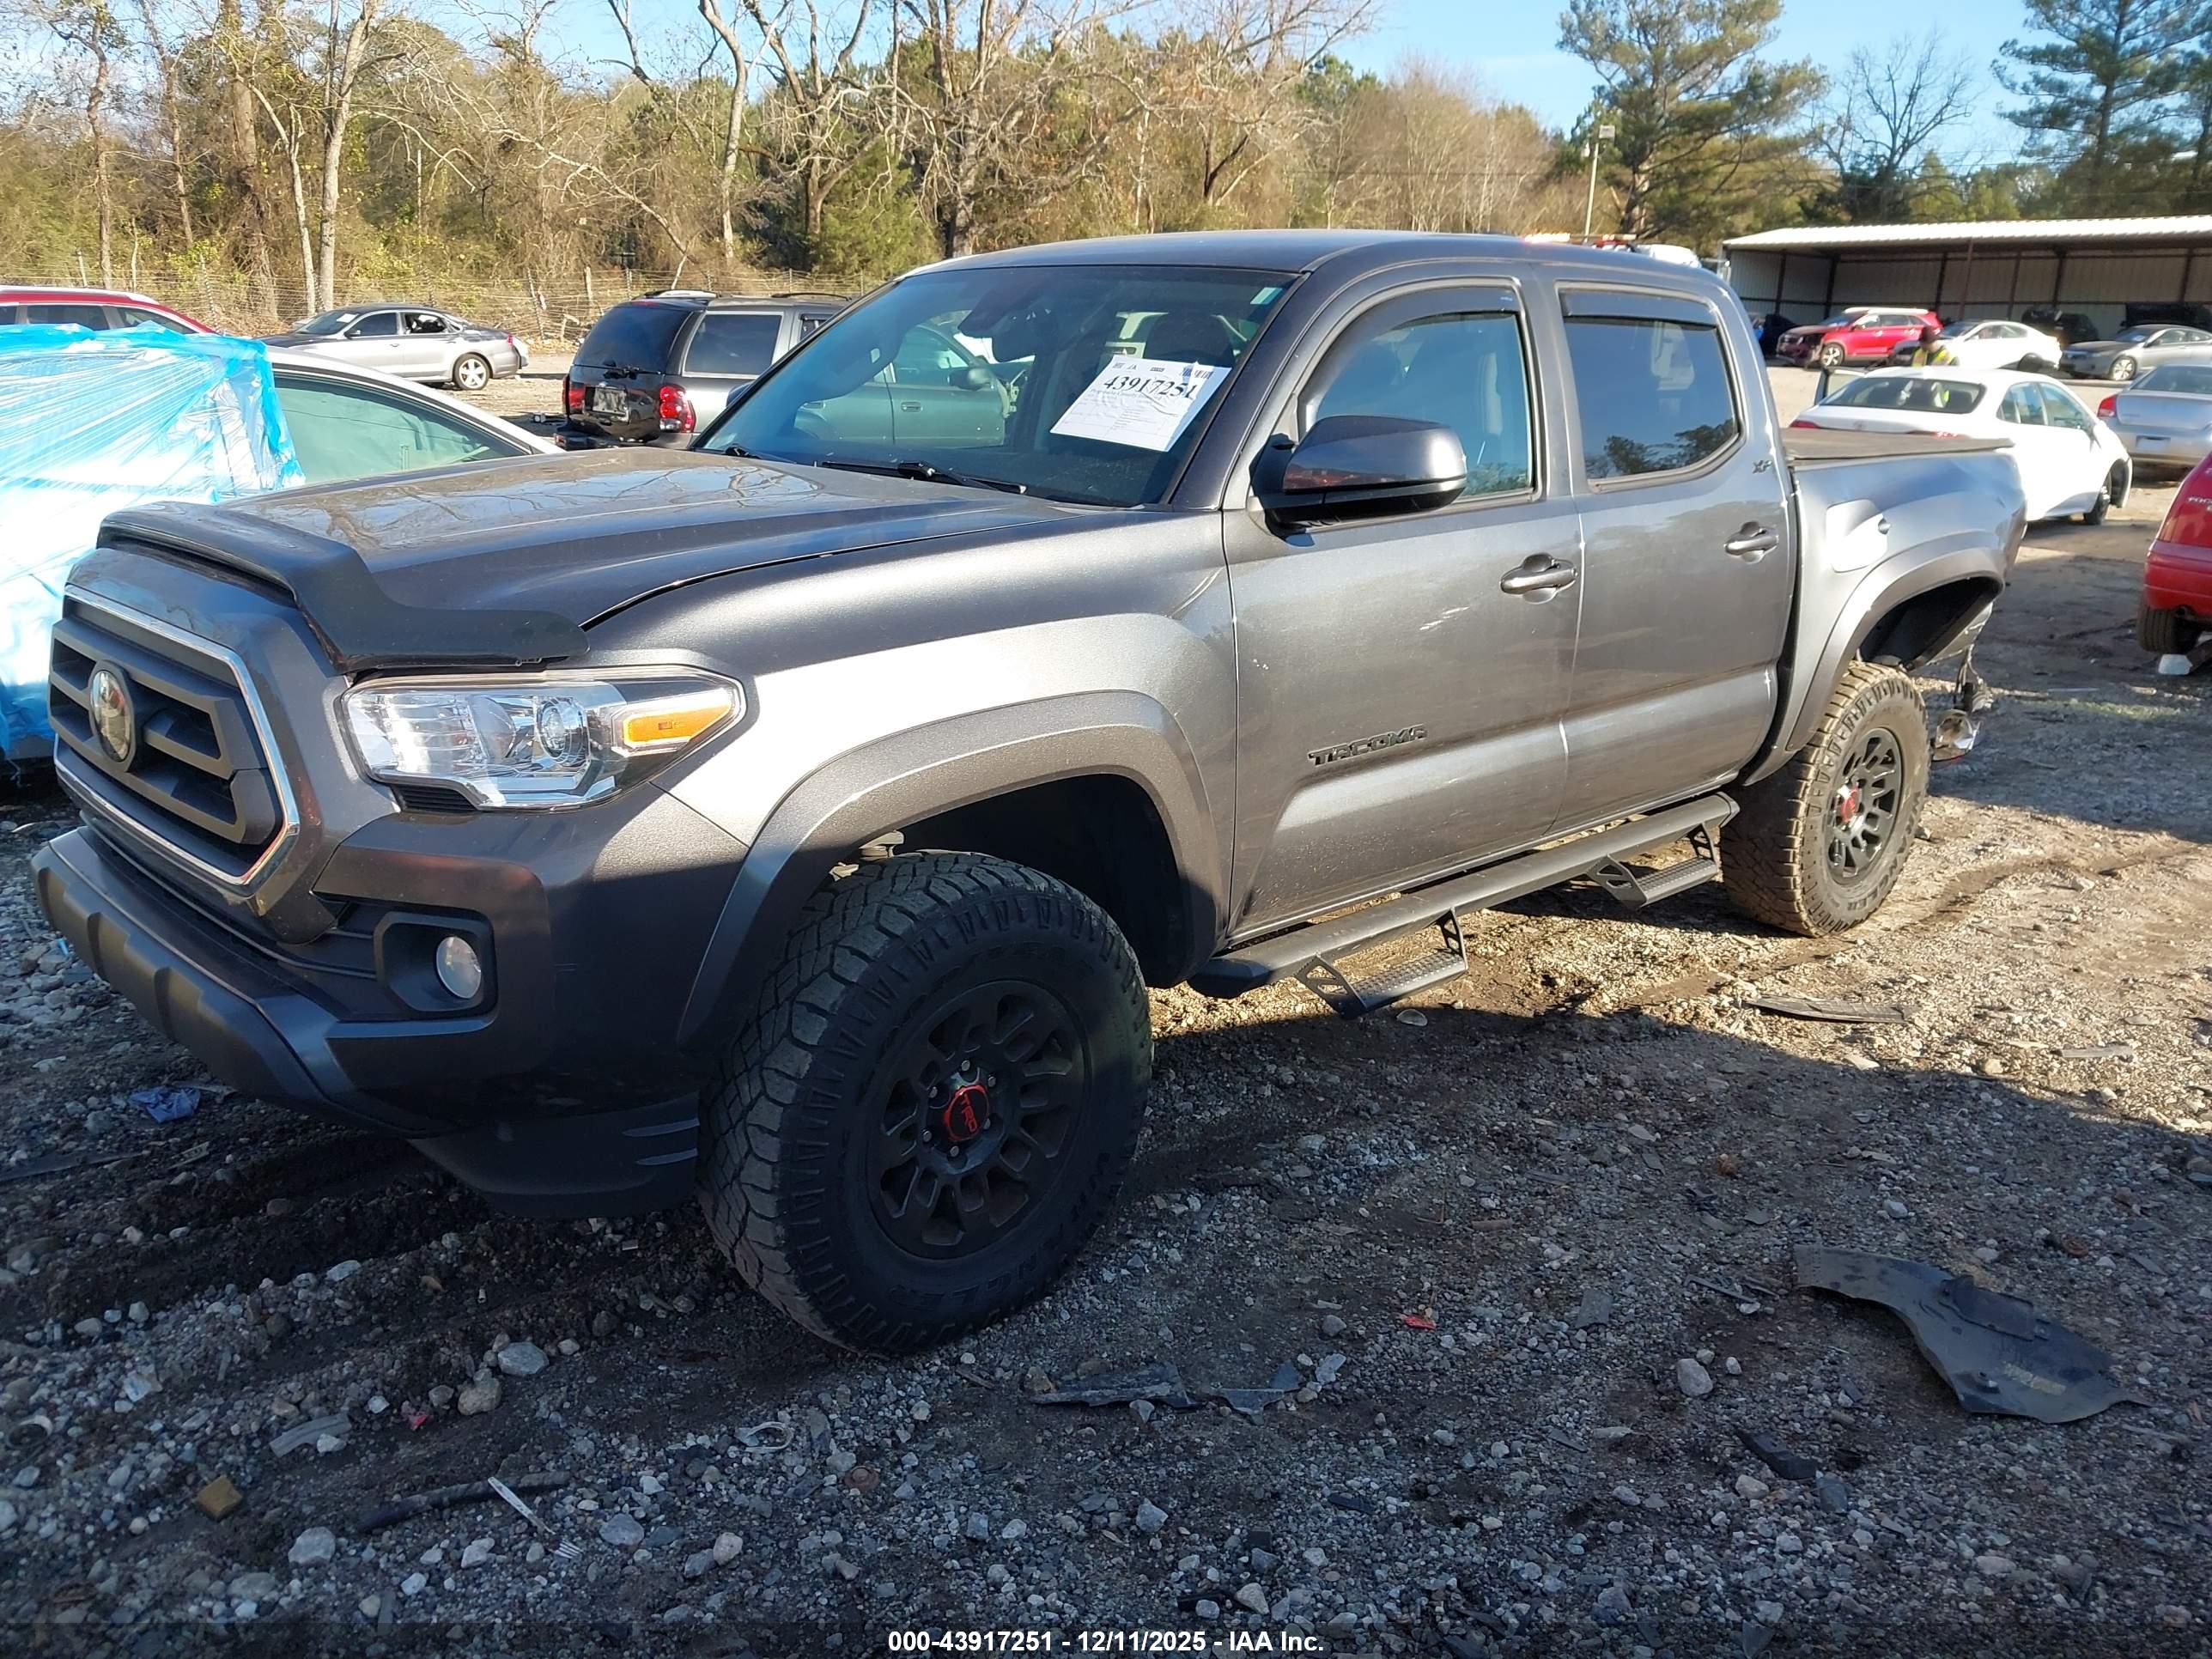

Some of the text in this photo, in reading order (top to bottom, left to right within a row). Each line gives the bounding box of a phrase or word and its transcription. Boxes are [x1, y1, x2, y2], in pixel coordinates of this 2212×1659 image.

[1104, 375, 1197, 400] 43917251
[1308, 724, 1429, 766] TACOMA
[961, 1093, 979, 1133] TRD
